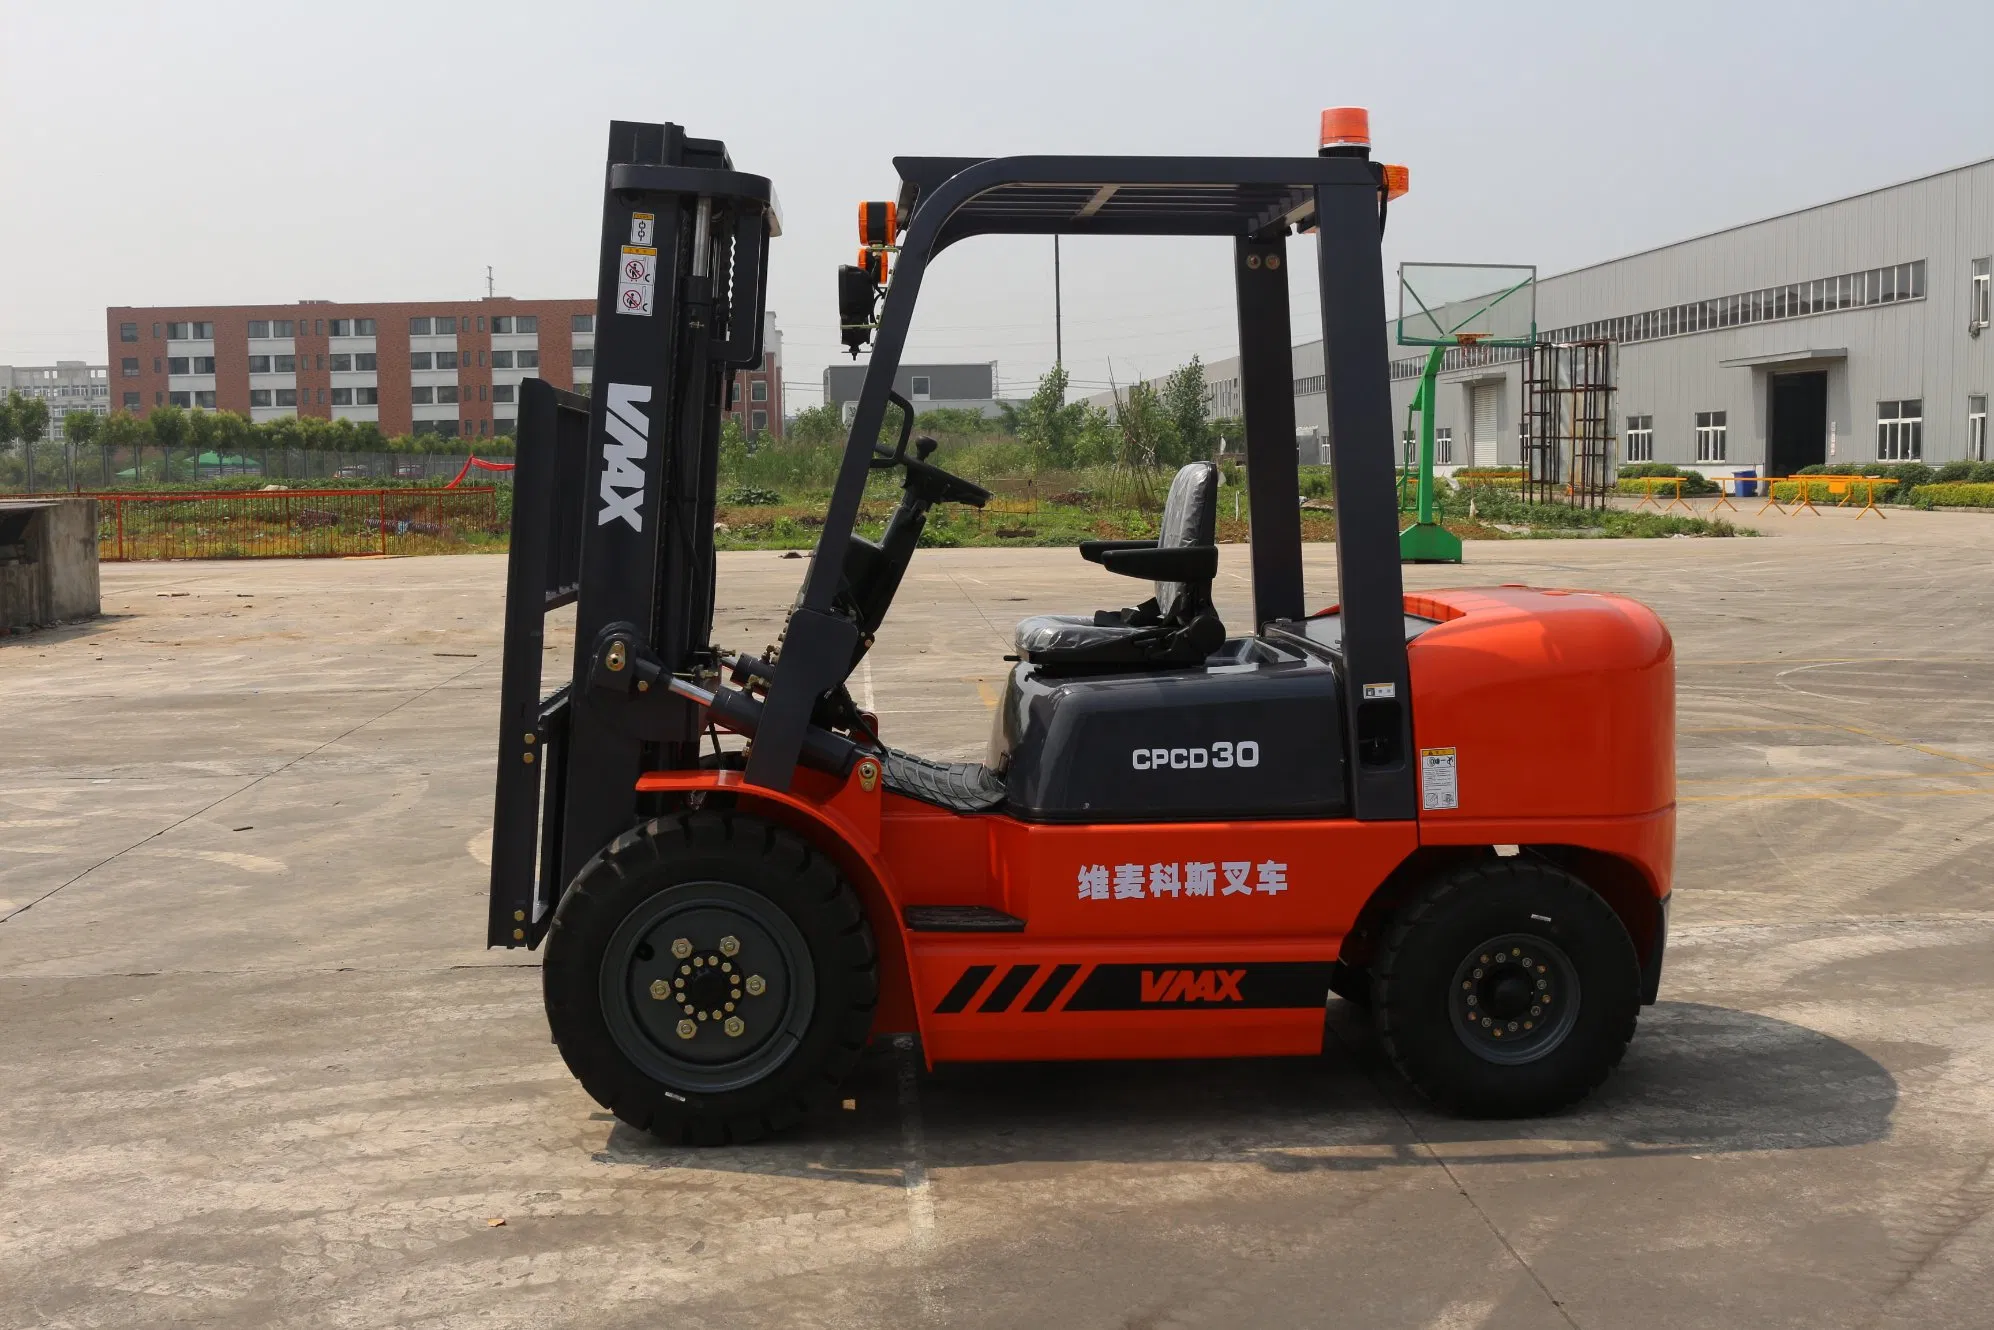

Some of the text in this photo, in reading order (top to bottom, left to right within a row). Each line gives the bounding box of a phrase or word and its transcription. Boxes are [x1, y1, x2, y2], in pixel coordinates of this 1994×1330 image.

[598, 383, 652, 533] VMAX
[1132, 741, 1259, 770] CPCD30
[1077, 860, 1288, 900] 维麦科斯叉车
[1140, 969, 1246, 1002] VMAX
